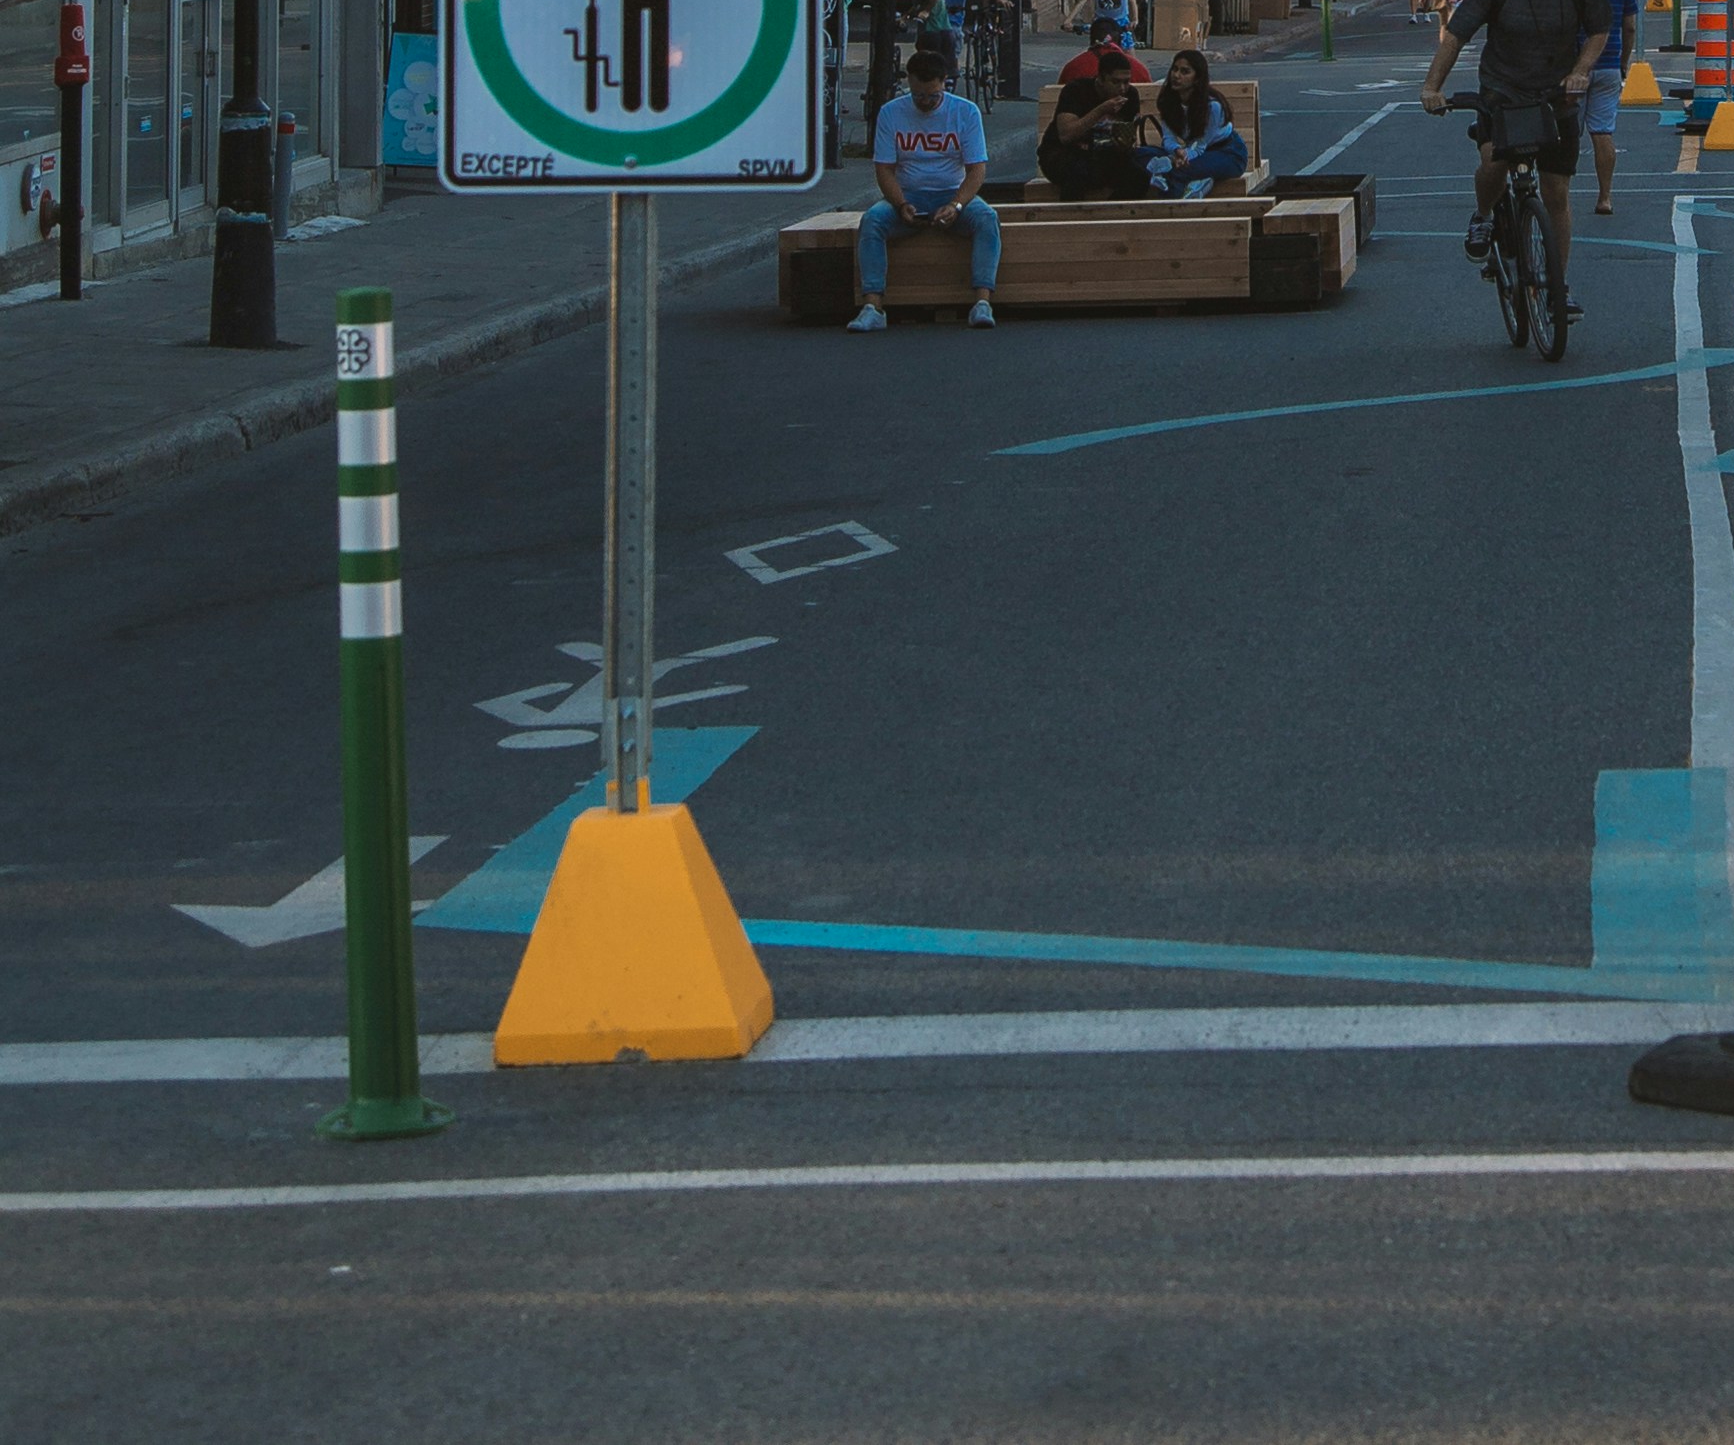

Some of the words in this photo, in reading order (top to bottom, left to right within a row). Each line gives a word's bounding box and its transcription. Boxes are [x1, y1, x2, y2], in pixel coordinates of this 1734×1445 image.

[896, 132, 960, 151] NASA
[460, 153, 554, 177] EXCEPTÉ
[737, 158, 795, 177] SPVM
